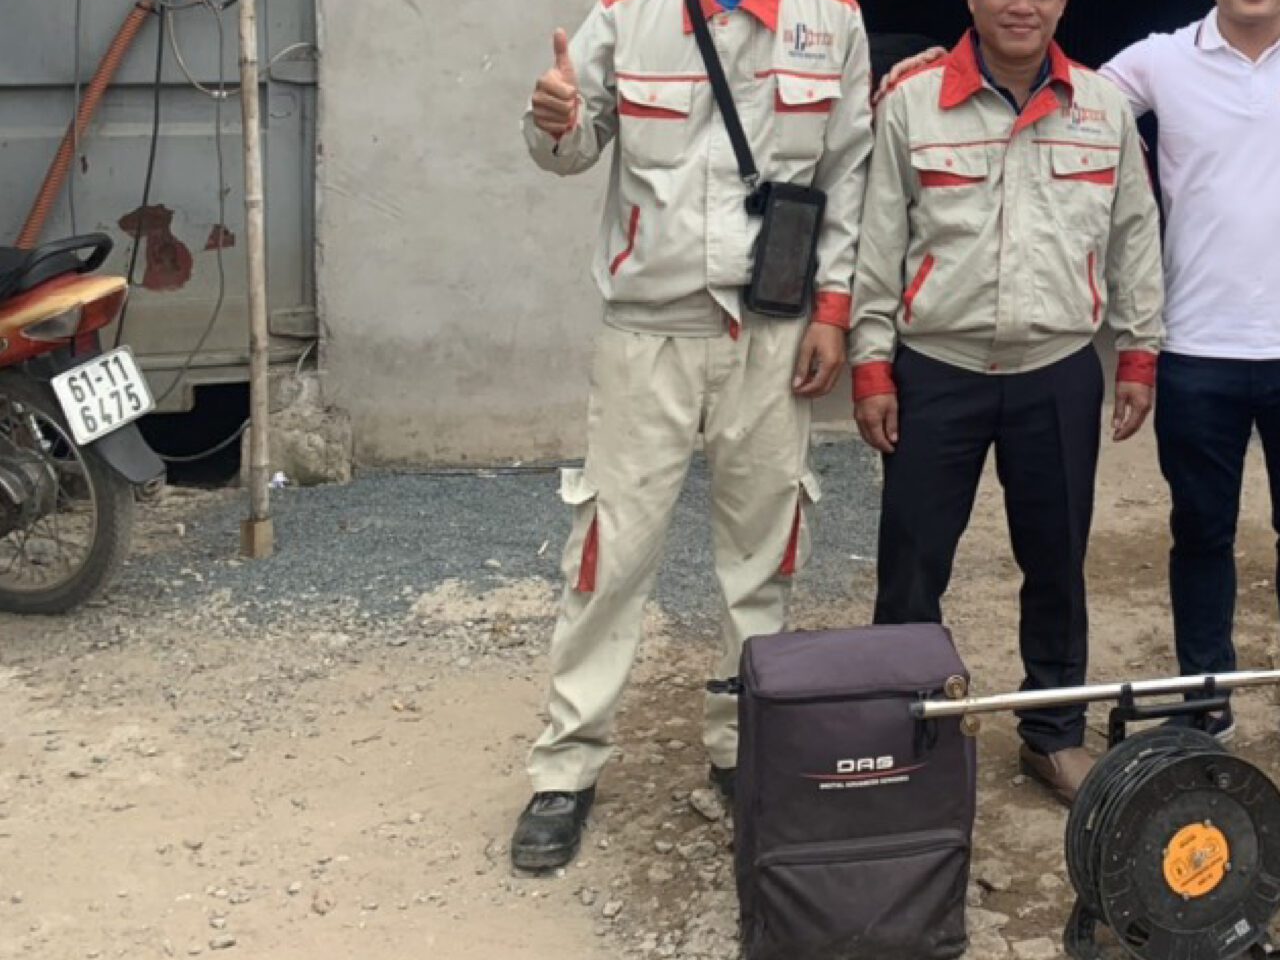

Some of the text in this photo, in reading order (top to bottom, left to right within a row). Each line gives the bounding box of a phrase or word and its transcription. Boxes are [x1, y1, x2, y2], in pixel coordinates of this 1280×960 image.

[68, 355, 128, 403] 61-T1
[81, 383, 141, 433] 6475
[836, 755, 894, 774] DAS
